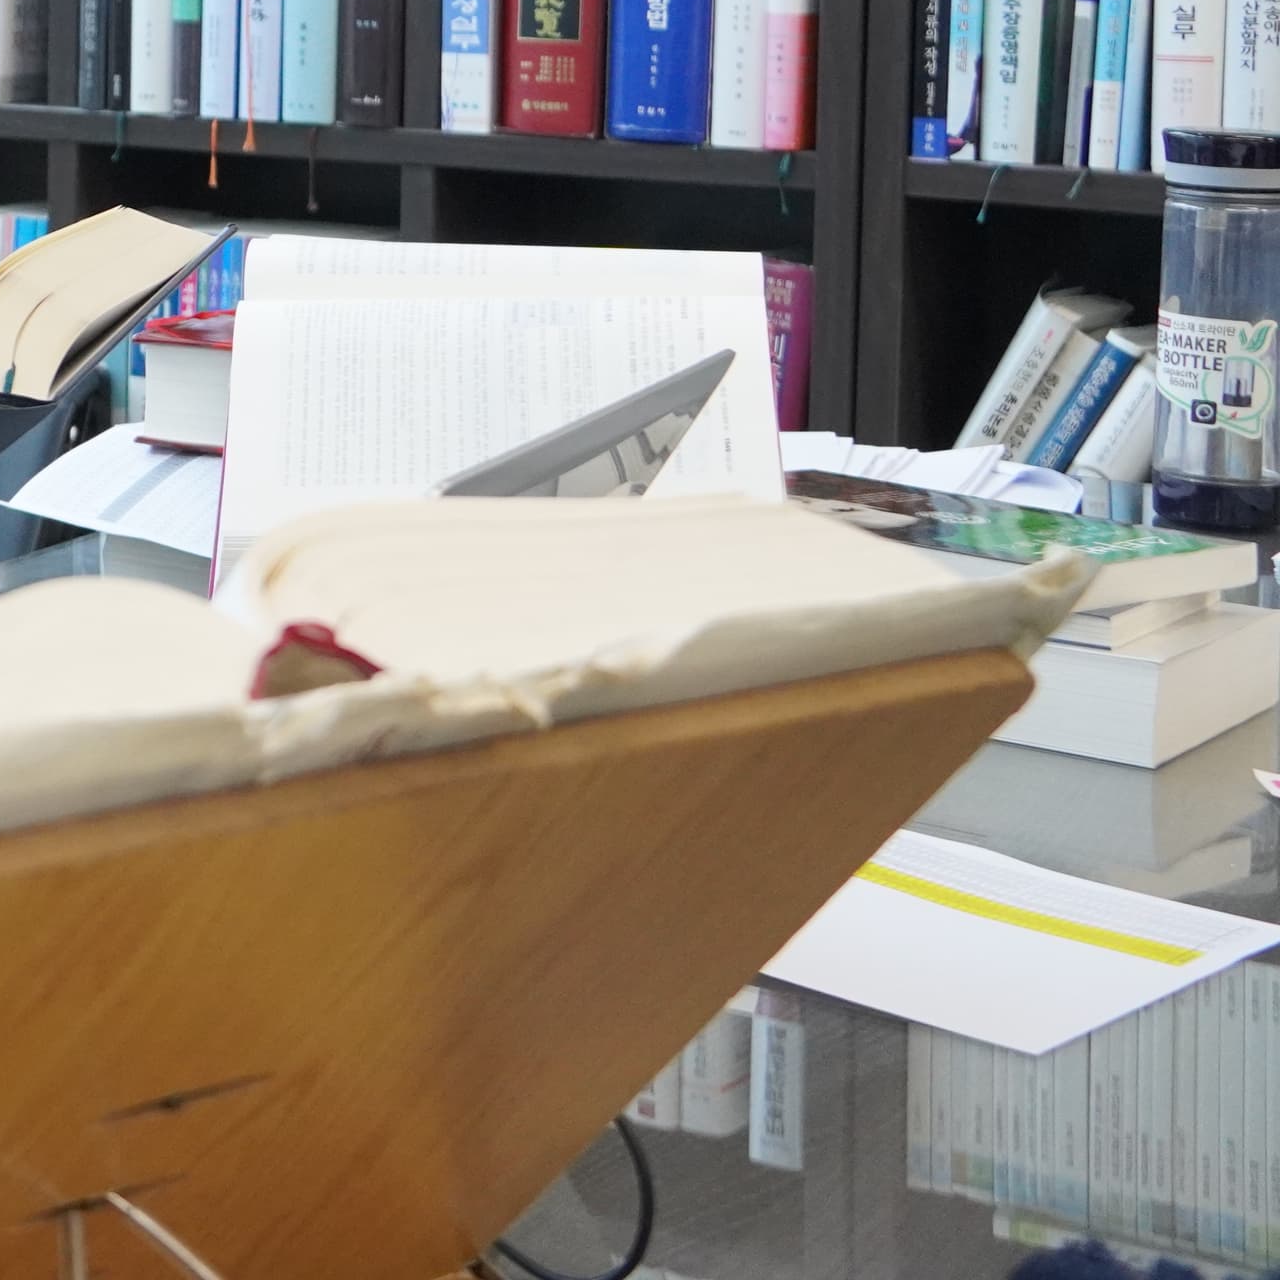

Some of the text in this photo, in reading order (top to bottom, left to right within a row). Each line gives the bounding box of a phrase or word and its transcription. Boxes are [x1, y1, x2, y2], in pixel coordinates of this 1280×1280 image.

[1171, 5, 1197, 40] 실무
[1198, 323, 1236, 337] 트라이탄
[1163, 349, 1224, 372] BOTTLE
